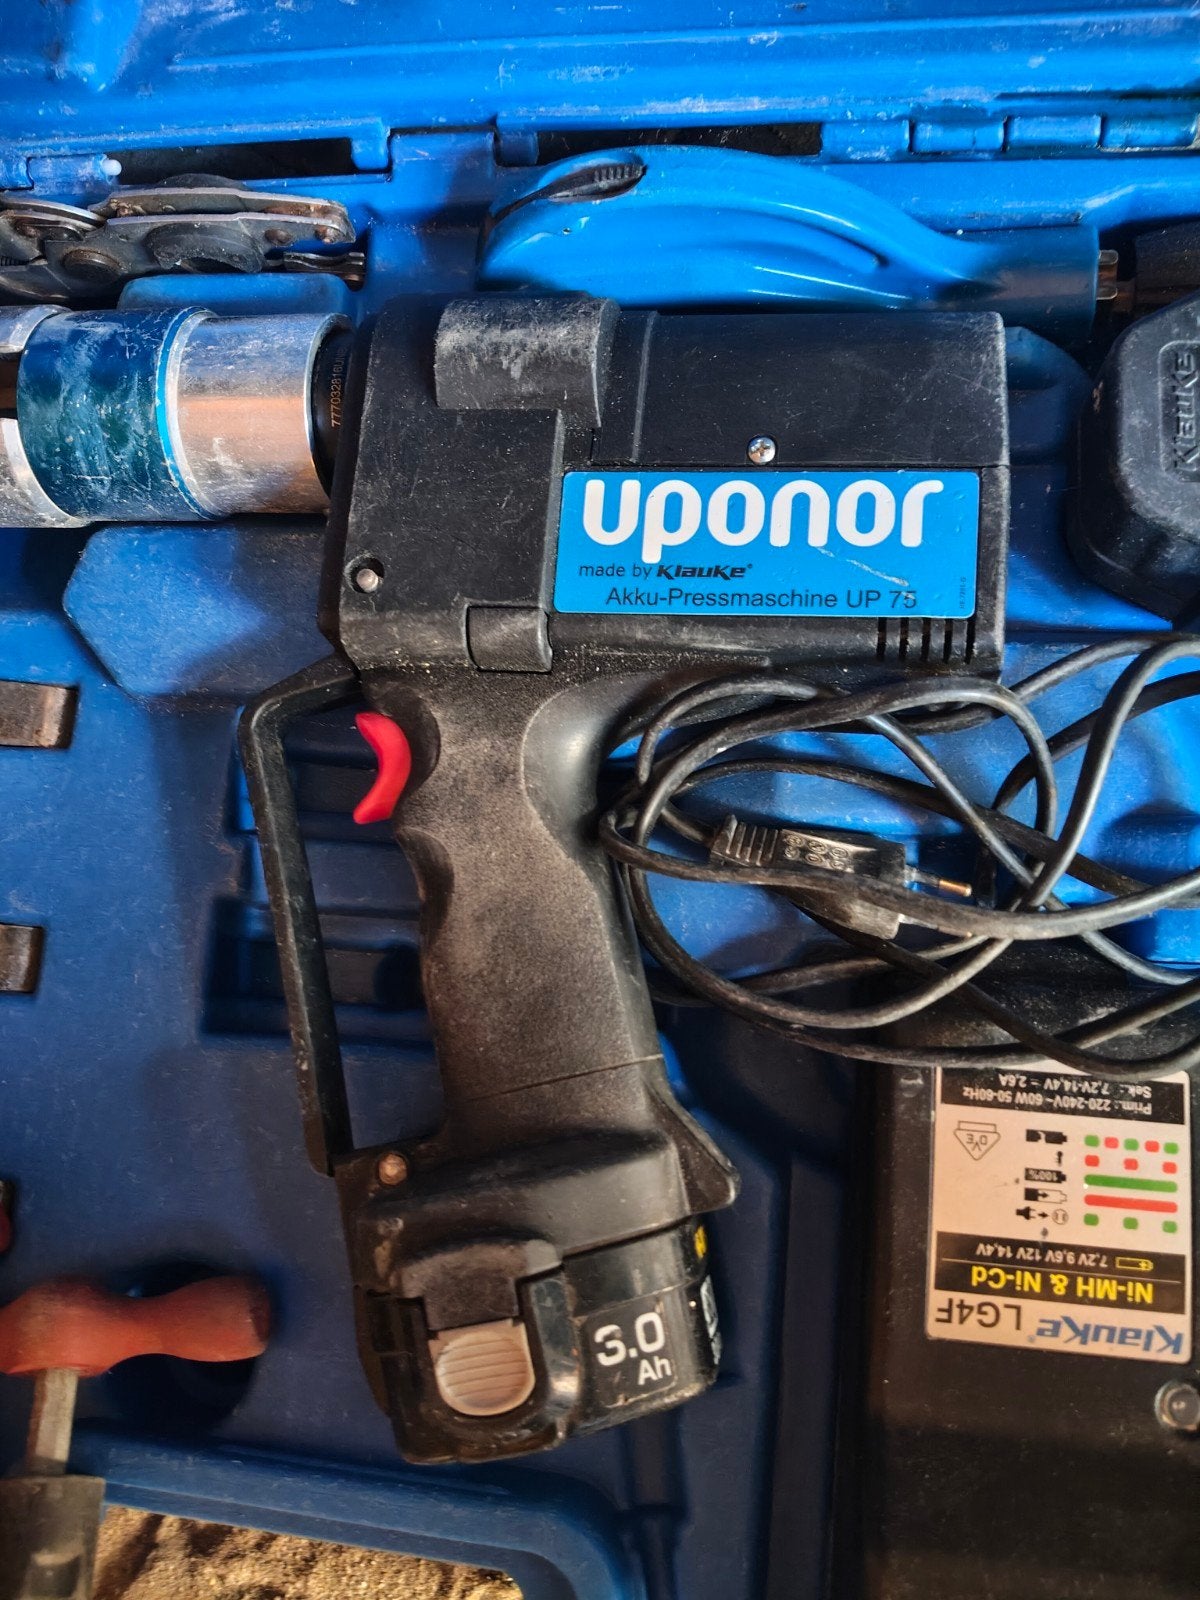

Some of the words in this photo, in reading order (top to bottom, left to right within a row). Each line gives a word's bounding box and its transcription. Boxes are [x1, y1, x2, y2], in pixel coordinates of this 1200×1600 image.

[582, 479, 945, 564] uponor
[578, 563, 626, 577] made
[632, 564, 653, 580] by
[605, 587, 838, 609] Akku-Pressmaschine
[846, 589, 881, 609] UP
[888, 589, 917, 609] 75
[998, 1073, 1027, 1089] 2,6A
[1043, 1077, 1110, 1095] 7,2V-14,4V
[962, 1085, 1013, 1102] 50-60Hz
[1015, 1090, 1043, 1106] 60W
[1027, 1169, 1058, 1182] 100%
[975, 1242, 1013, 1259] 14,4V
[1015, 1246, 1042, 1261] 12V
[1045, 1250, 1075, 1264] 9,6V
[1077, 1253, 1109, 1268] 7,2V
[971, 1265, 1042, 1293] Ni-Cd
[1050, 1273, 1069, 1295] &
[1076, 1276, 1154, 1304] Ni-MH
[935, 1297, 1022, 1331] LG4F
[594, 1312, 666, 1366] 3.0
[638, 1355, 672, 1386] Ah
